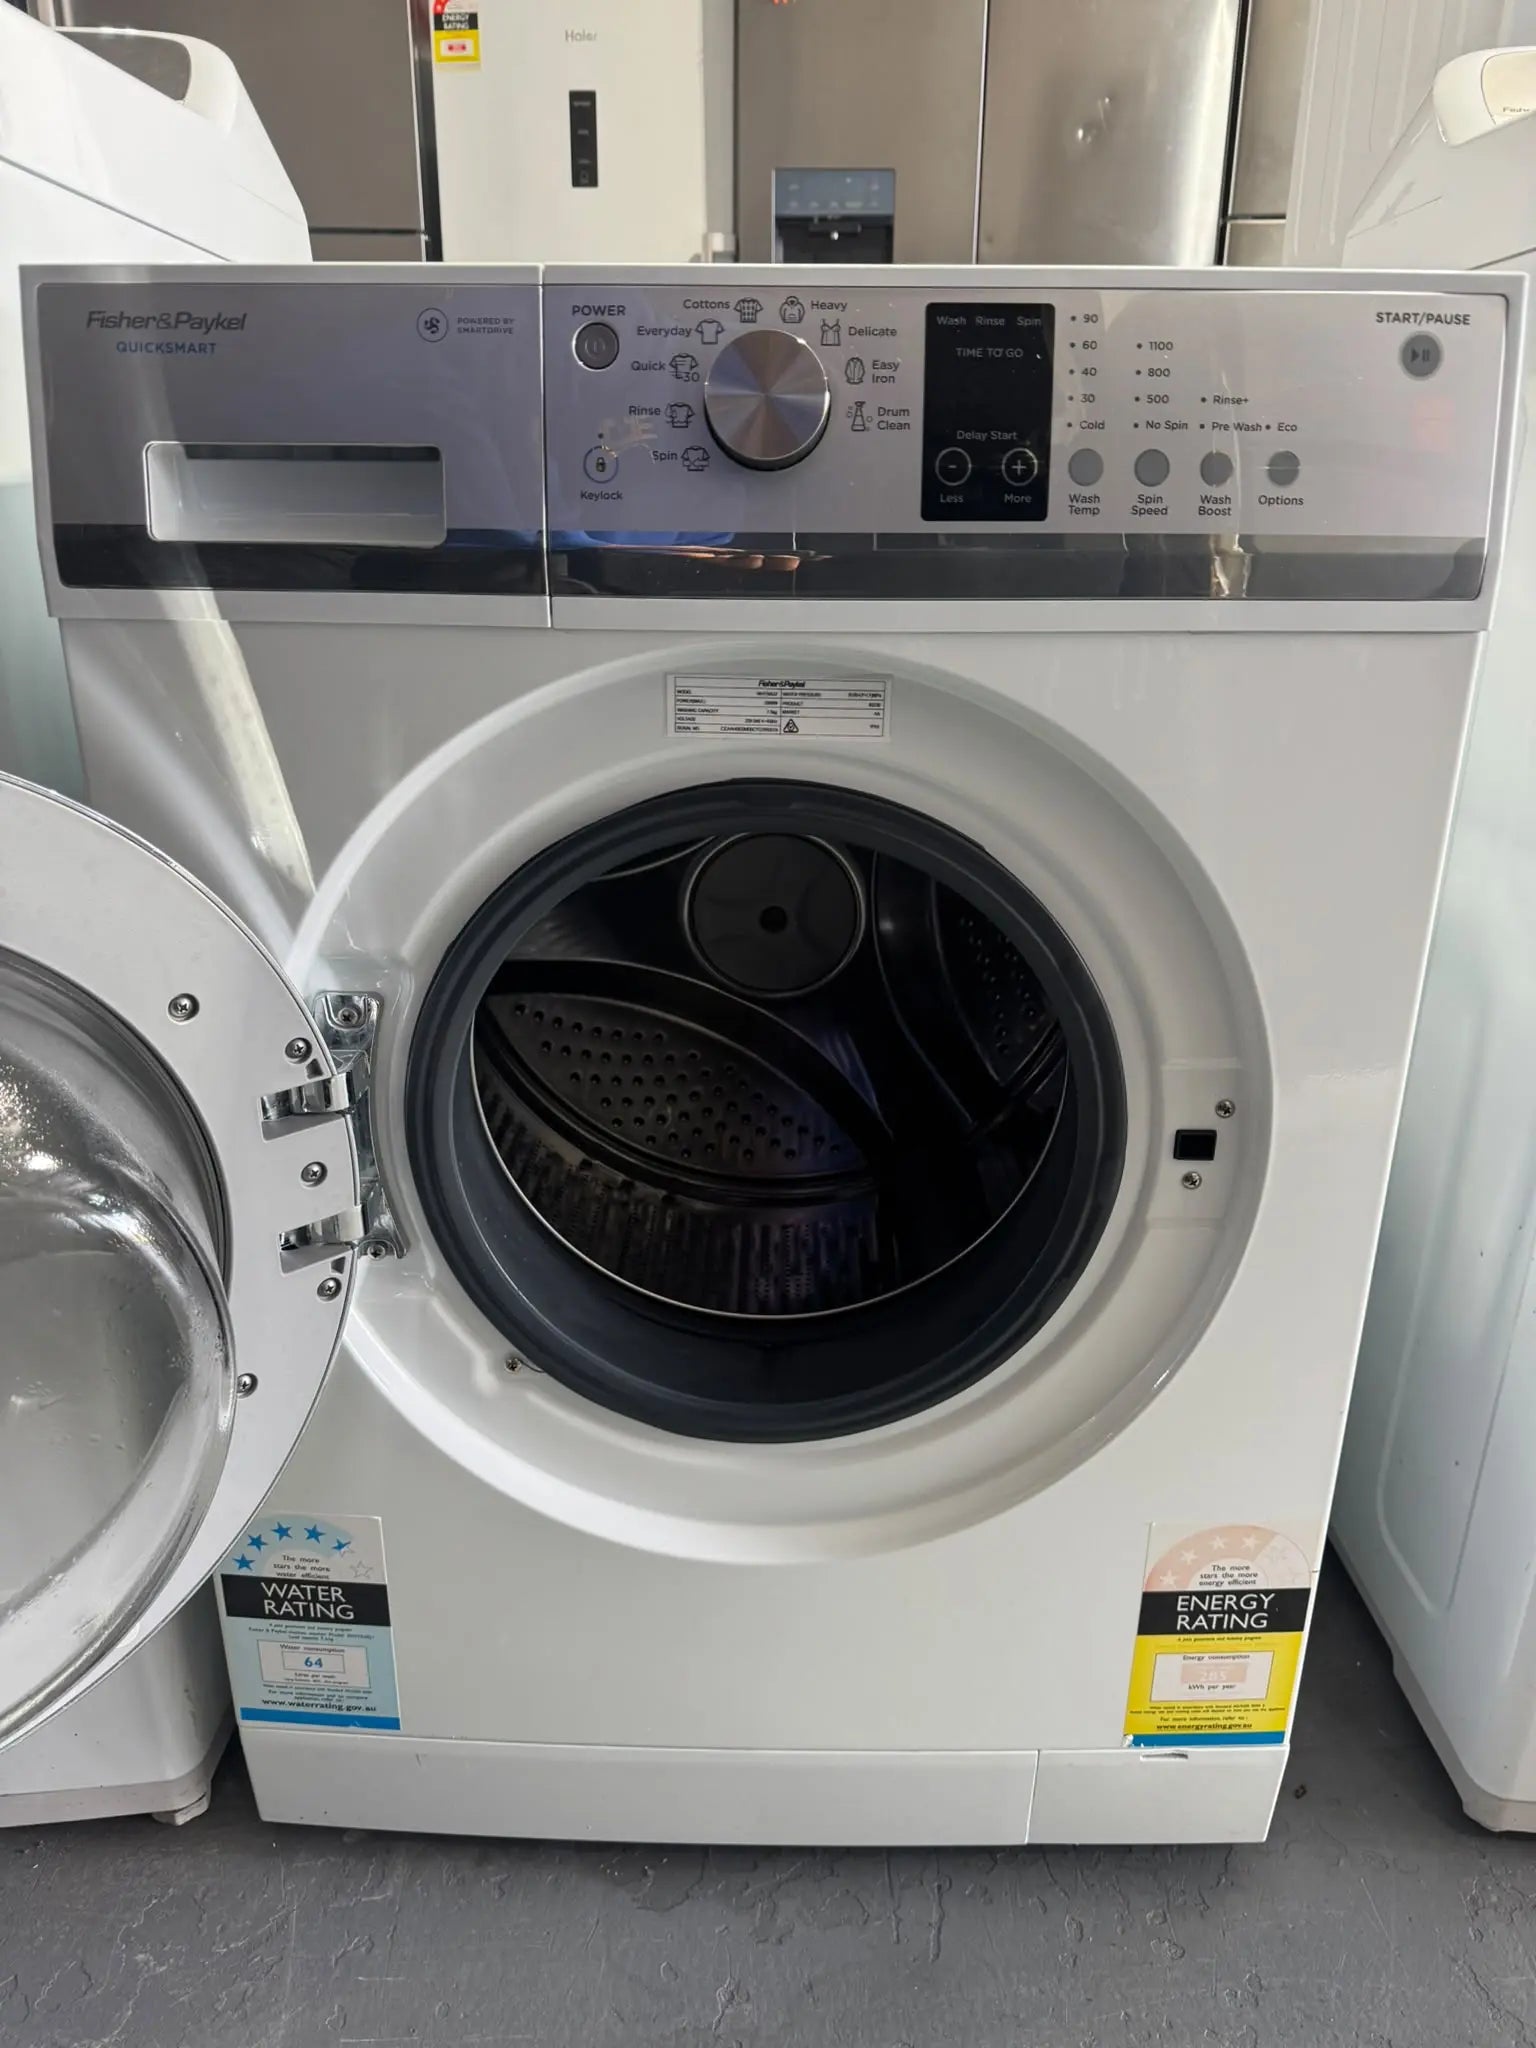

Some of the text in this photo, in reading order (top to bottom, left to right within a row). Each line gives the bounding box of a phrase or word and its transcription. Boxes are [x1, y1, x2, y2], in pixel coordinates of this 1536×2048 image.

[565, 30, 597, 42] Haier
[683, 299, 730, 309] Cottons
[811, 300, 848, 312] Heavy
[572, 305, 626, 317] POWER
[86, 310, 247, 335] Fisher&Paykel
[457, 317, 514, 325] POWERED BY
[936, 316, 967, 326] Wash
[975, 316, 1005, 326] Rinse
[1016, 316, 1042, 328] Spin
[1083, 314, 1099, 324] 90
[1376, 311, 1471, 326] START/PAUSE
[457, 327, 514, 335] SMARTDRIVE
[637, 325, 692, 338] Everyday
[848, 326, 898, 337] Delicate
[116, 341, 217, 355] QUICKSMART
[1082, 340, 1098, 350] 60
[1148, 341, 1174, 351] 1100
[956, 347, 1024, 358] TIME TO GO
[631, 360, 666, 373] Quick
[872, 360, 900, 372] Easy
[683, 371, 700, 383] 30
[1081, 367, 1097, 377] 40
[1147, 367, 1171, 377] 800
[872, 373, 896, 384] Iron
[1080, 393, 1096, 403] 30
[1146, 394, 1170, 404] 500
[1213, 395, 1249, 405] Rinse+
[628, 405, 661, 417] Rinse
[877, 406, 910, 417] Drum
[877, 420, 911, 431] Clean
[1079, 420, 1106, 430] Cold
[1145, 420, 1189, 432] No Spin
[1211, 422, 1262, 432] Pre Wash
[1277, 422, 1298, 432] Eco
[956, 430, 1017, 441] Delay Start
[652, 450, 678, 463] Spin
[580, 490, 624, 502] Keylock
[940, 493, 964, 503] Less
[1003, 494, 1032, 503] More
[1068, 494, 1100, 504] Wash
[1137, 494, 1164, 505] Spin
[1200, 494, 1232, 505] Wash
[1258, 495, 1305, 507] Options
[1068, 506, 1100, 517] Temp
[1131, 506, 1168, 517] Speed
[1198, 505, 1232, 516] Boost
[260, 1582, 346, 1603] WATER
[1176, 1592, 1276, 1612] ENERGY
[263, 1599, 355, 1620] RATING
[1176, 1612, 1269, 1631] RATING
[304, 1656, 323, 1669] 64
[261, 1698, 377, 1712] www.waterrating.gov.au
